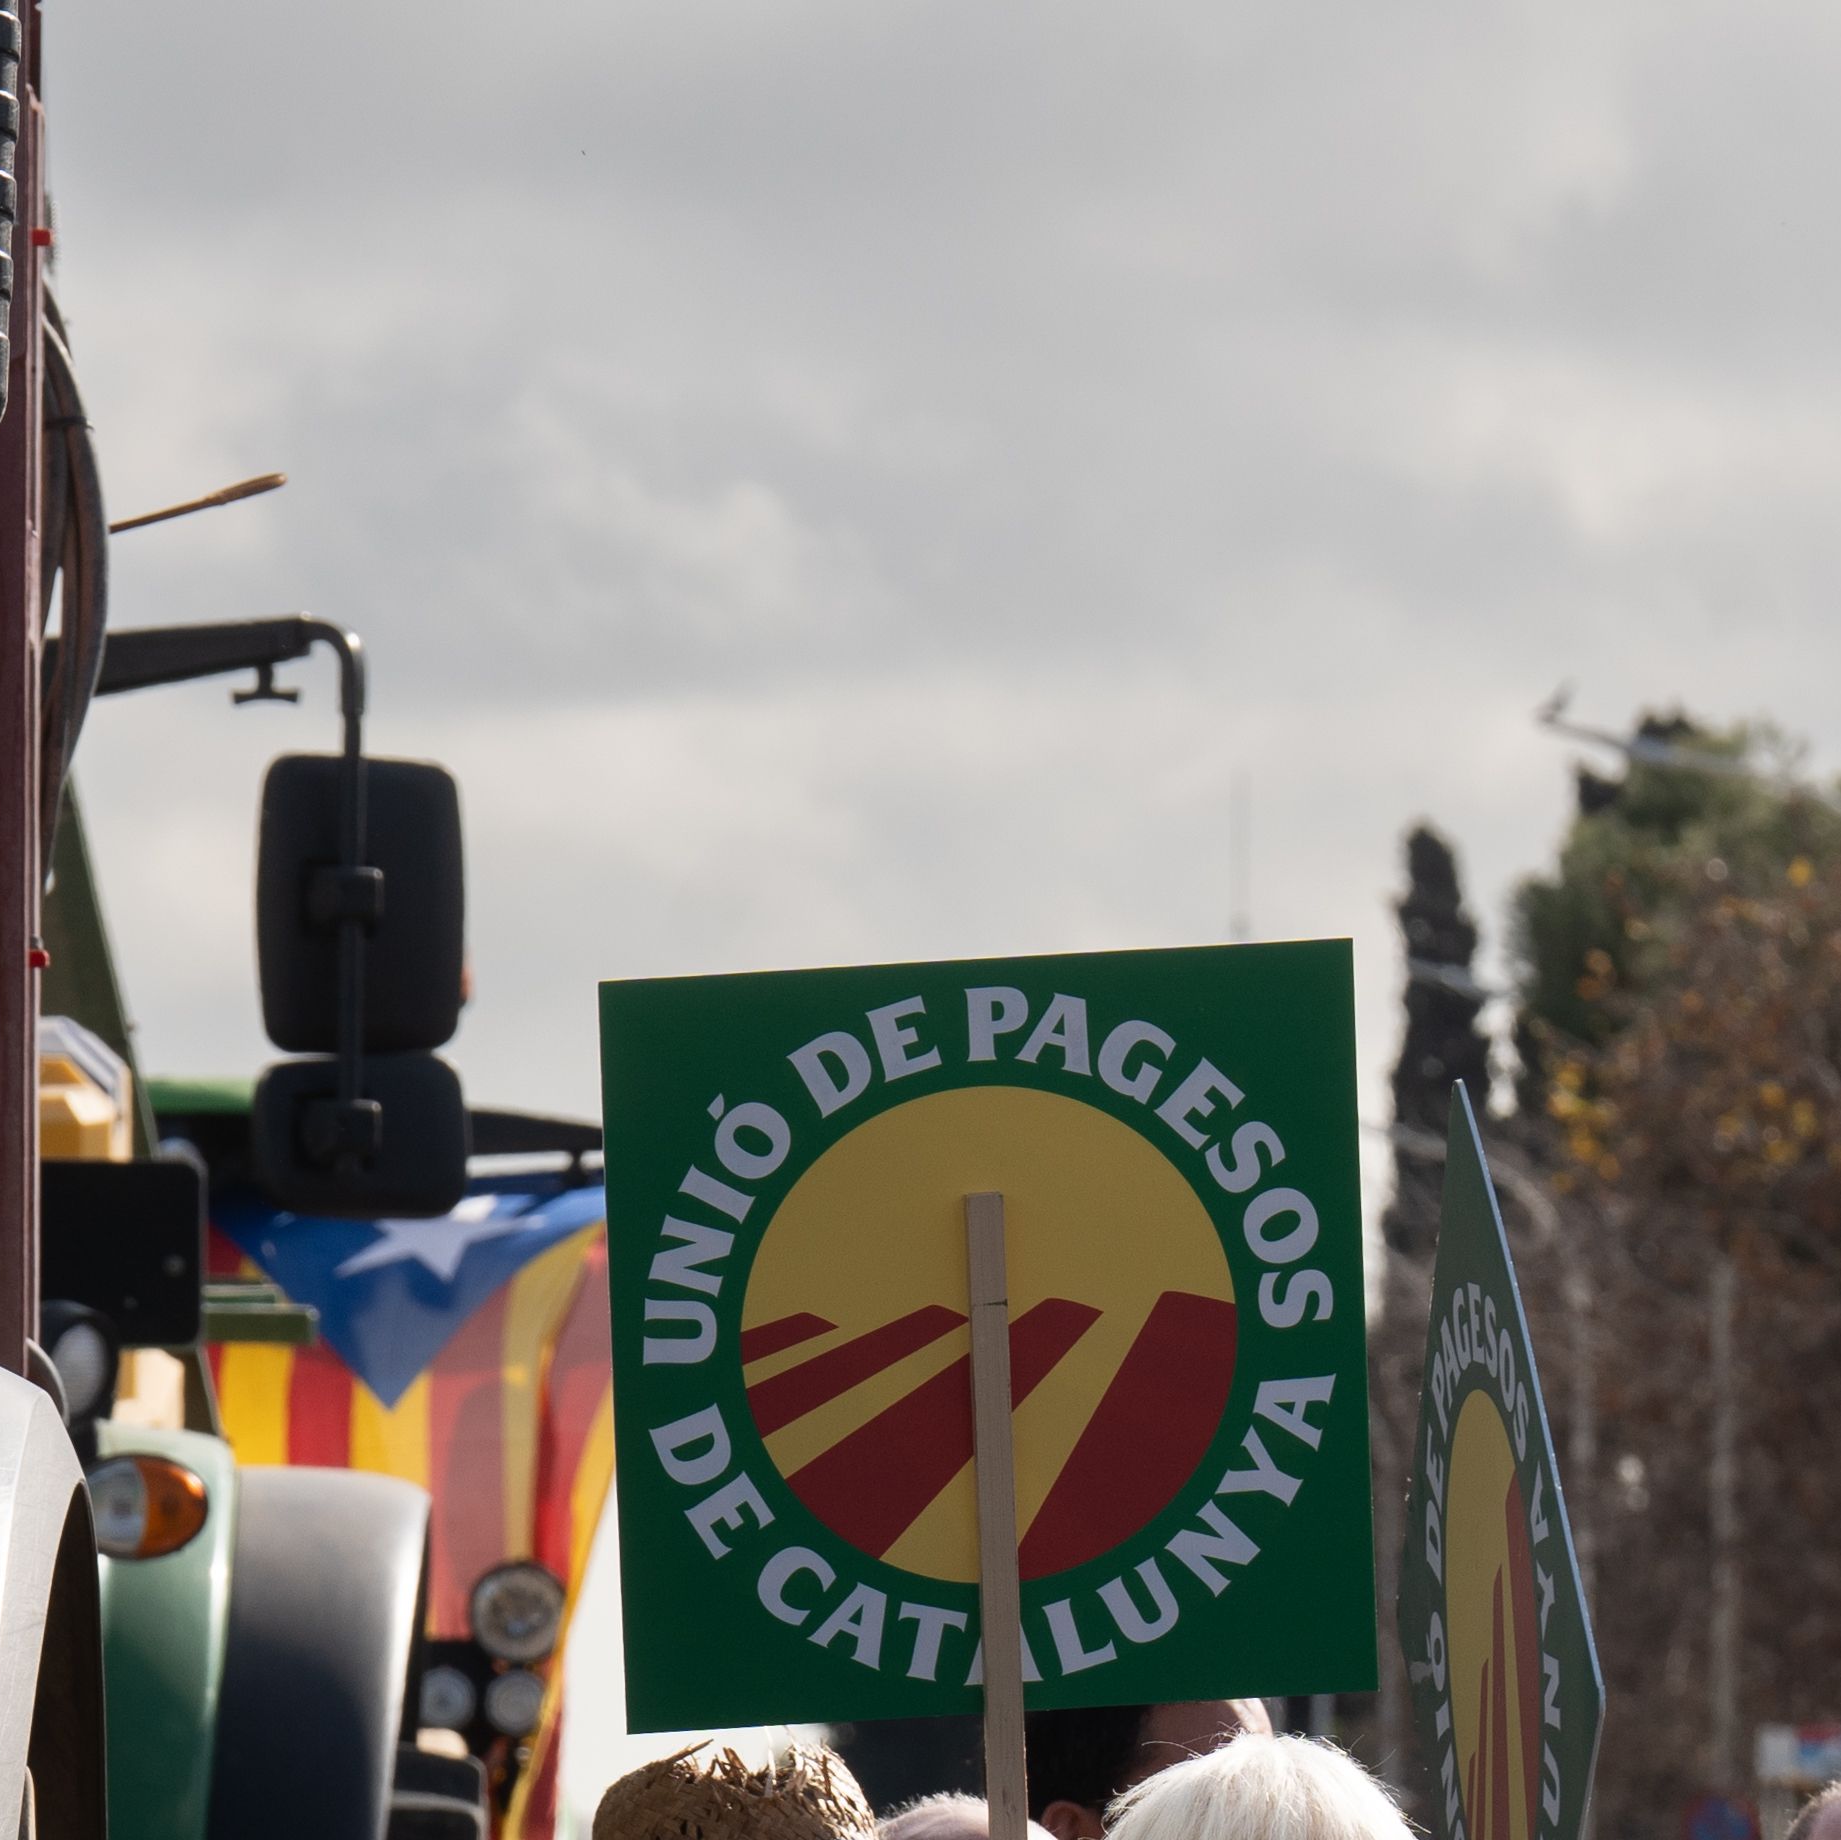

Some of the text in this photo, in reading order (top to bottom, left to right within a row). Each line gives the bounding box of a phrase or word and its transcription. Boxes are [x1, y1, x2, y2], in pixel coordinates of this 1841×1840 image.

[641, 985, 1335, 1366] UNIÓ DE PAGESOS
[1430, 1281, 1530, 1463] PAGESOS
[648, 1402, 776, 1562] DE
[1425, 1422, 1445, 1587] DE
